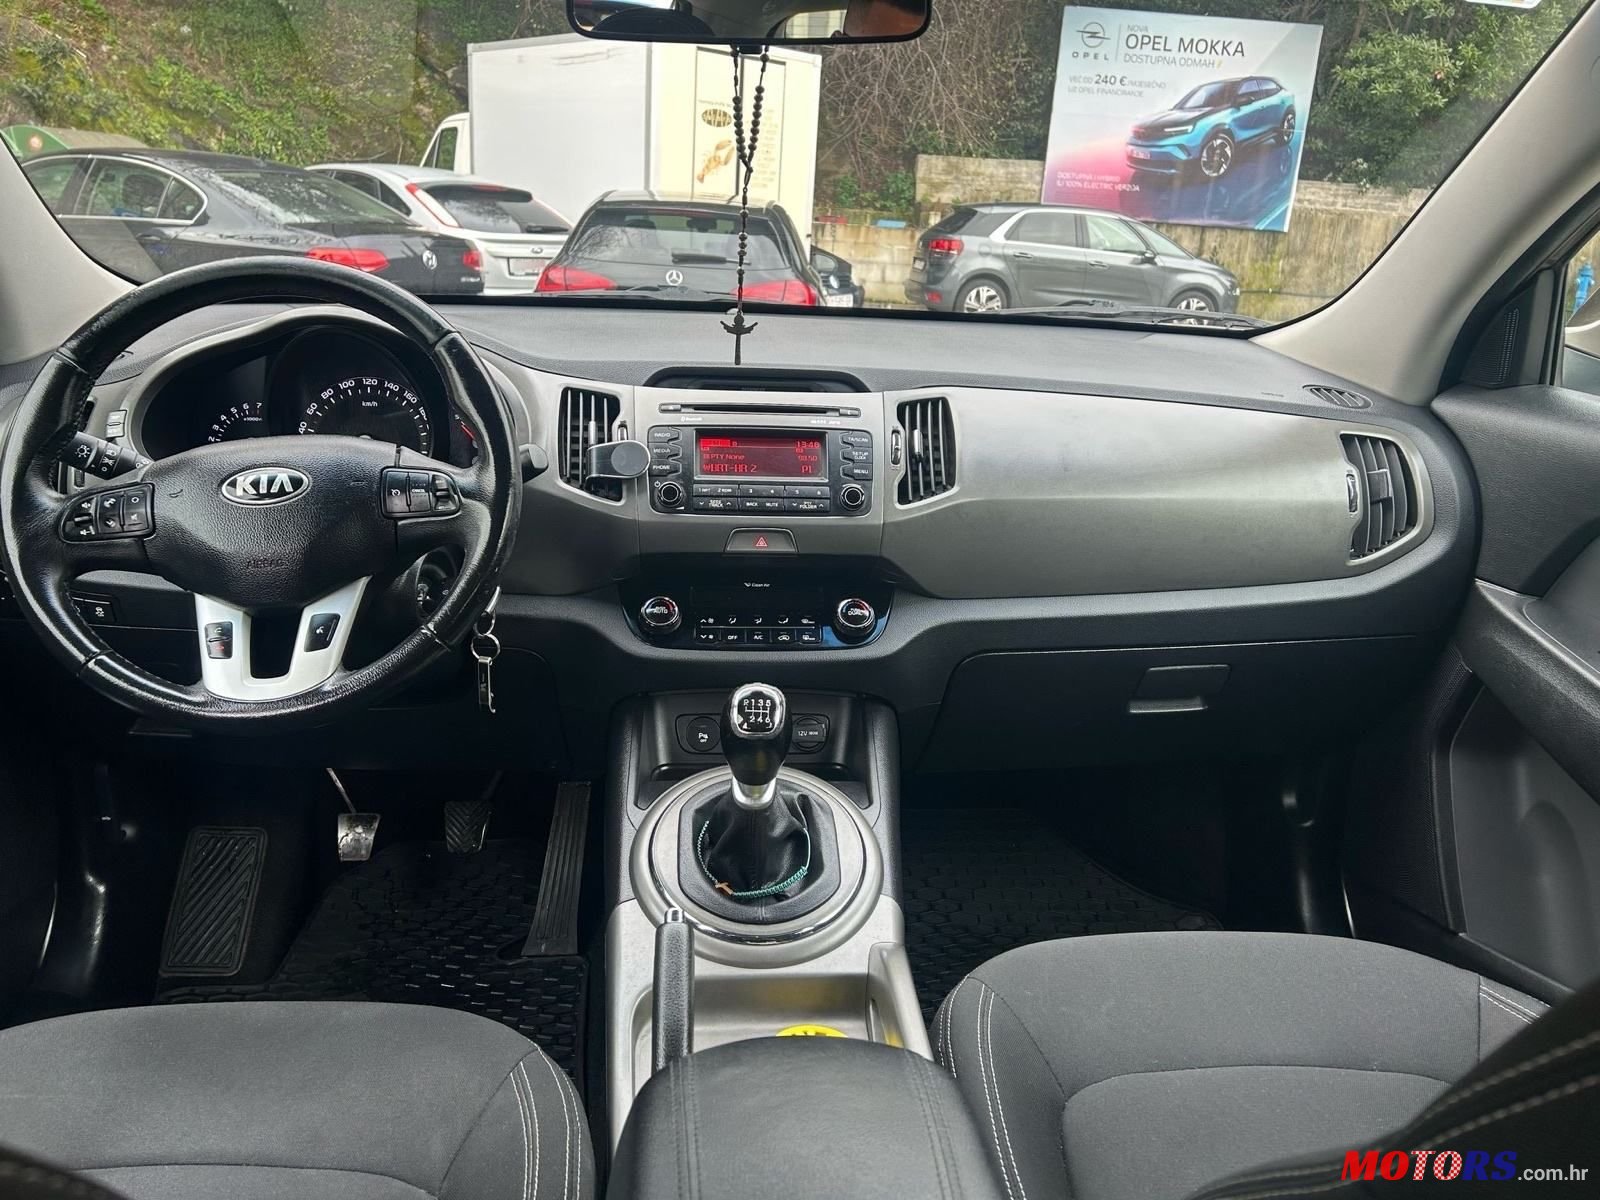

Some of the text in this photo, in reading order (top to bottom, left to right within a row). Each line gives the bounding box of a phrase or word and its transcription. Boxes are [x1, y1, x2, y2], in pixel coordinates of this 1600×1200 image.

[1127, 24, 1149, 33] NOVA
[1125, 33, 1246, 57] OPEL MOKKA
[1071, 51, 1110, 61] OPEL
[1123, 53, 1216, 69] DOSTUPNA ODMAH
[1094, 74, 1117, 86] 240
[1119, 75, 1128, 86] €
[338, 380, 355, 390] 100
[363, 378, 378, 386] 120
[384, 380, 400, 392] 140
[320, 388, 335, 400] 80
[403, 390, 418, 404] 160
[230, 406, 238, 414] 5
[306, 402, 318, 416] 60
[298, 421, 308, 434] 40
[235, 472, 294, 496] KIA
[743, 698, 750, 706] R
[758, 698, 764, 706] 3
[765, 699, 771, 707] 5
